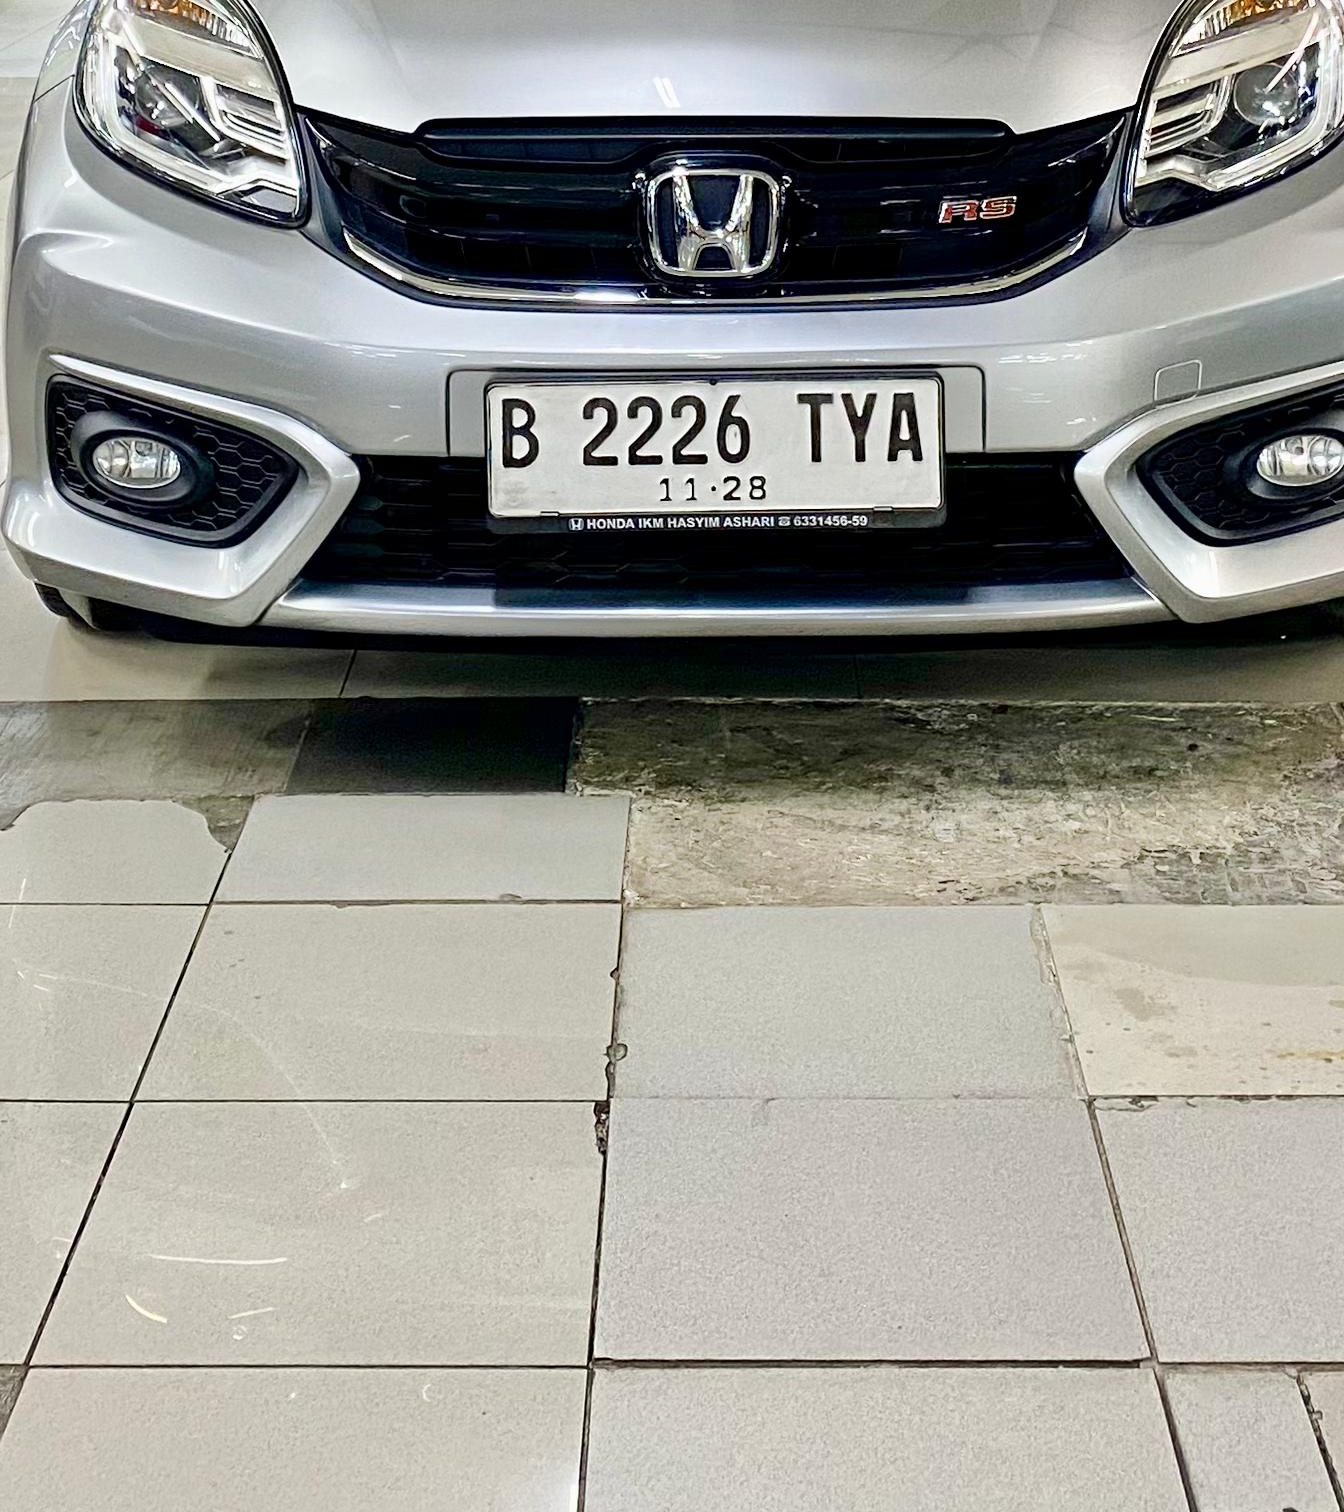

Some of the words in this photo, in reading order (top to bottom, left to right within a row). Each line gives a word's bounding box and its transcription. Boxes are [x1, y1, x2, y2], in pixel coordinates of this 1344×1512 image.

[938, 195, 1017, 224] RS
[501, 398, 540, 469] B
[582, 394, 751, 467] 2226
[796, 391, 924, 464] TYA
[587, 517, 635, 530] HONDA
[638, 517, 664, 529] IKM
[667, 516, 720, 529] HASYIM
[723, 516, 775, 528] ASHARI
[793, 515, 869, 527] 6331456-59
